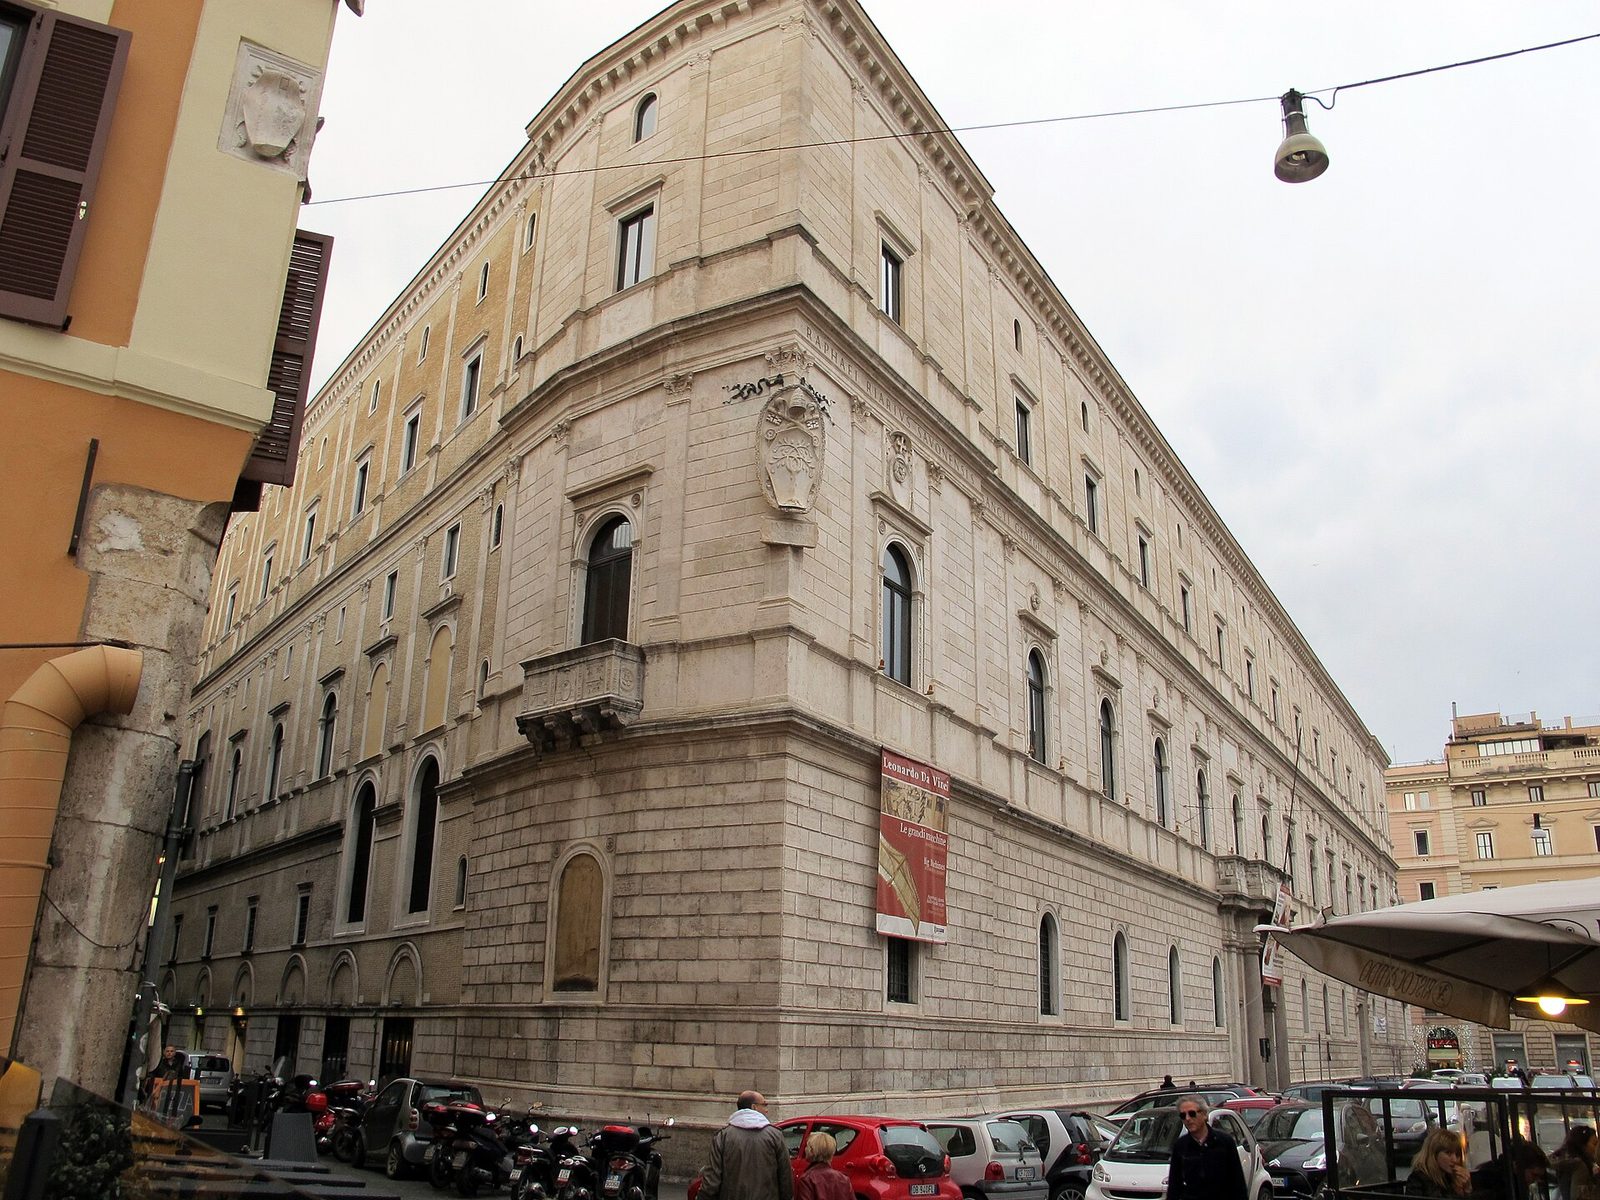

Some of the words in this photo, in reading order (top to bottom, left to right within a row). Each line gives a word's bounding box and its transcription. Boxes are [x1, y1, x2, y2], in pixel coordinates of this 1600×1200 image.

[883, 757, 920, 780] Leonardo
[921, 771, 930, 784] Da
[932, 775, 949, 792] Vinci
[900, 822, 908, 834] Le
[1430, 1039, 1458, 1048] PIZZA
